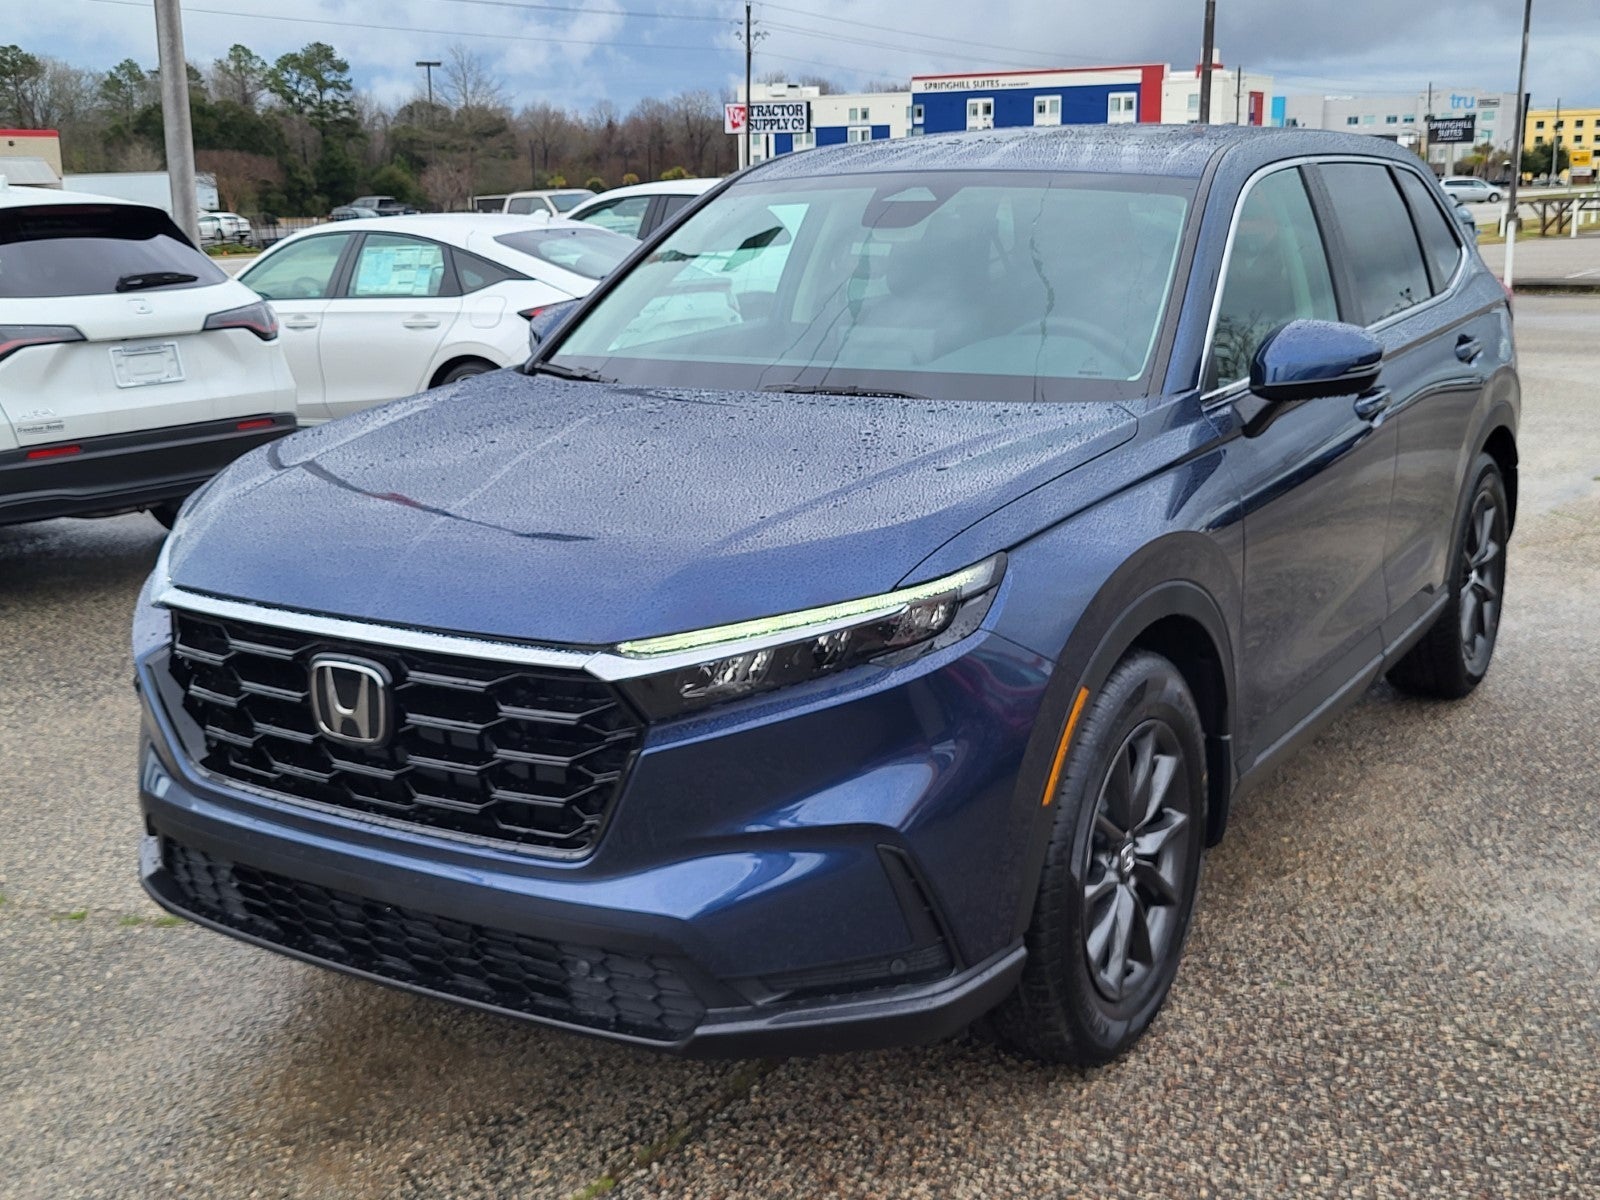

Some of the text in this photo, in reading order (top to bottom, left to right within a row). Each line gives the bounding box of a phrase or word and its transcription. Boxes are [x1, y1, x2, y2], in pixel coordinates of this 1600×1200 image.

[924, 81, 971, 91] SPRINGHILL
[972, 79, 1000, 89] SUITES
[1450, 94, 1475, 109] tru
[749, 104, 804, 117] TRACTOR
[749, 118, 790, 131] SUPPLY
